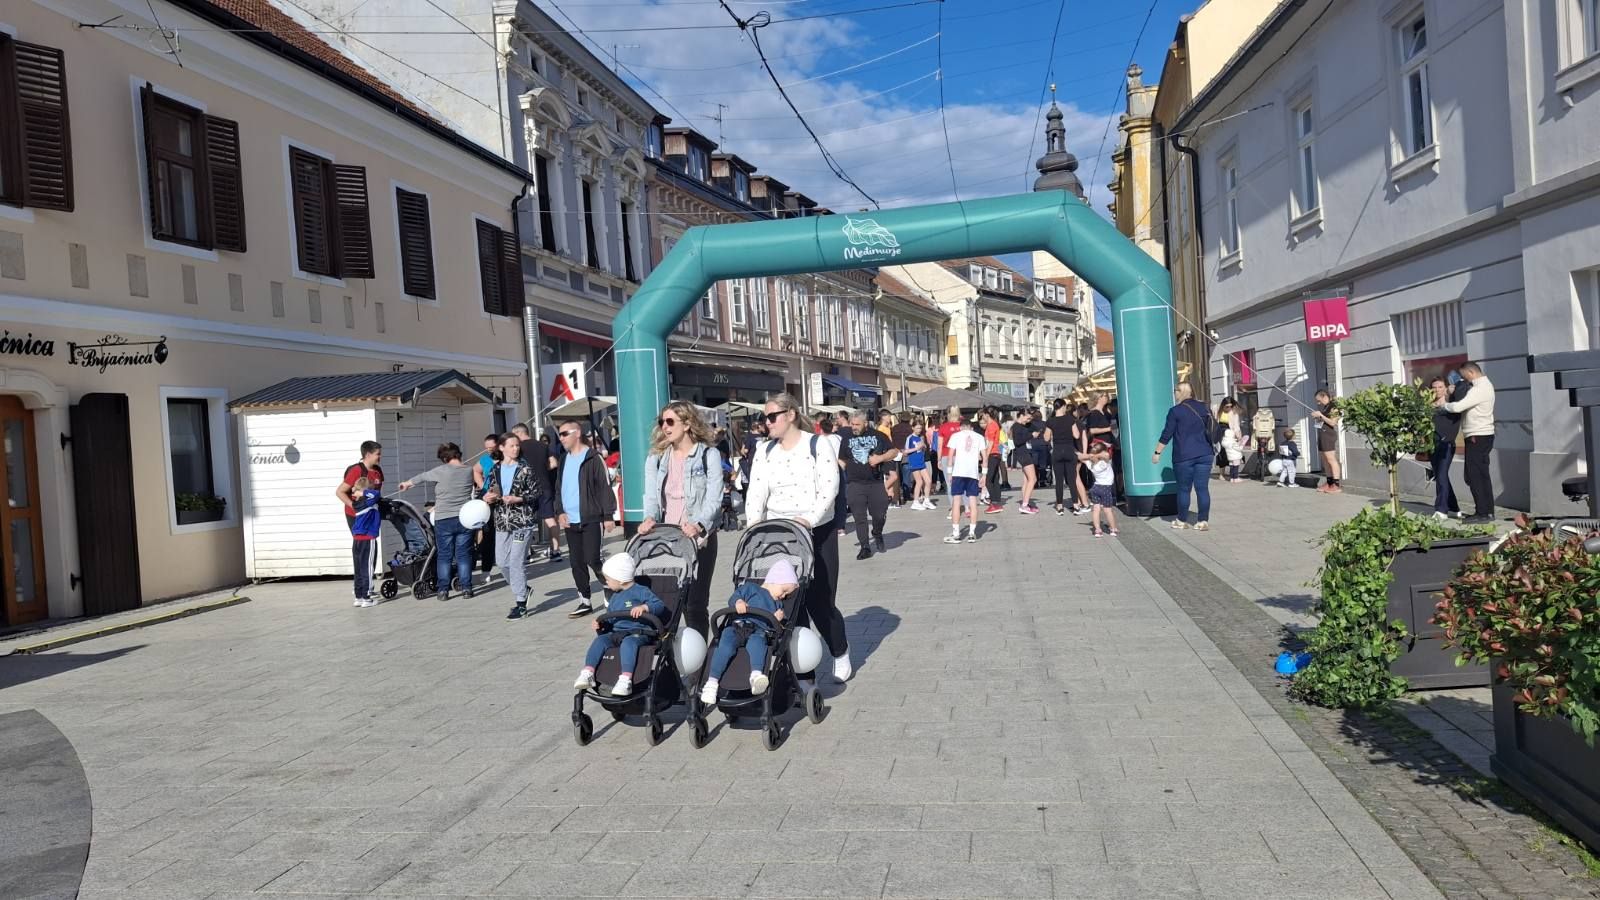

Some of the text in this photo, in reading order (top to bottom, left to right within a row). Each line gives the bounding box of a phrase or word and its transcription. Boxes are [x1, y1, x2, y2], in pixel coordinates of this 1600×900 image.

[1309, 323, 1347, 339] BIPA
[81, 348, 153, 374] Brijačnica
[549, 369, 579, 402] A1
